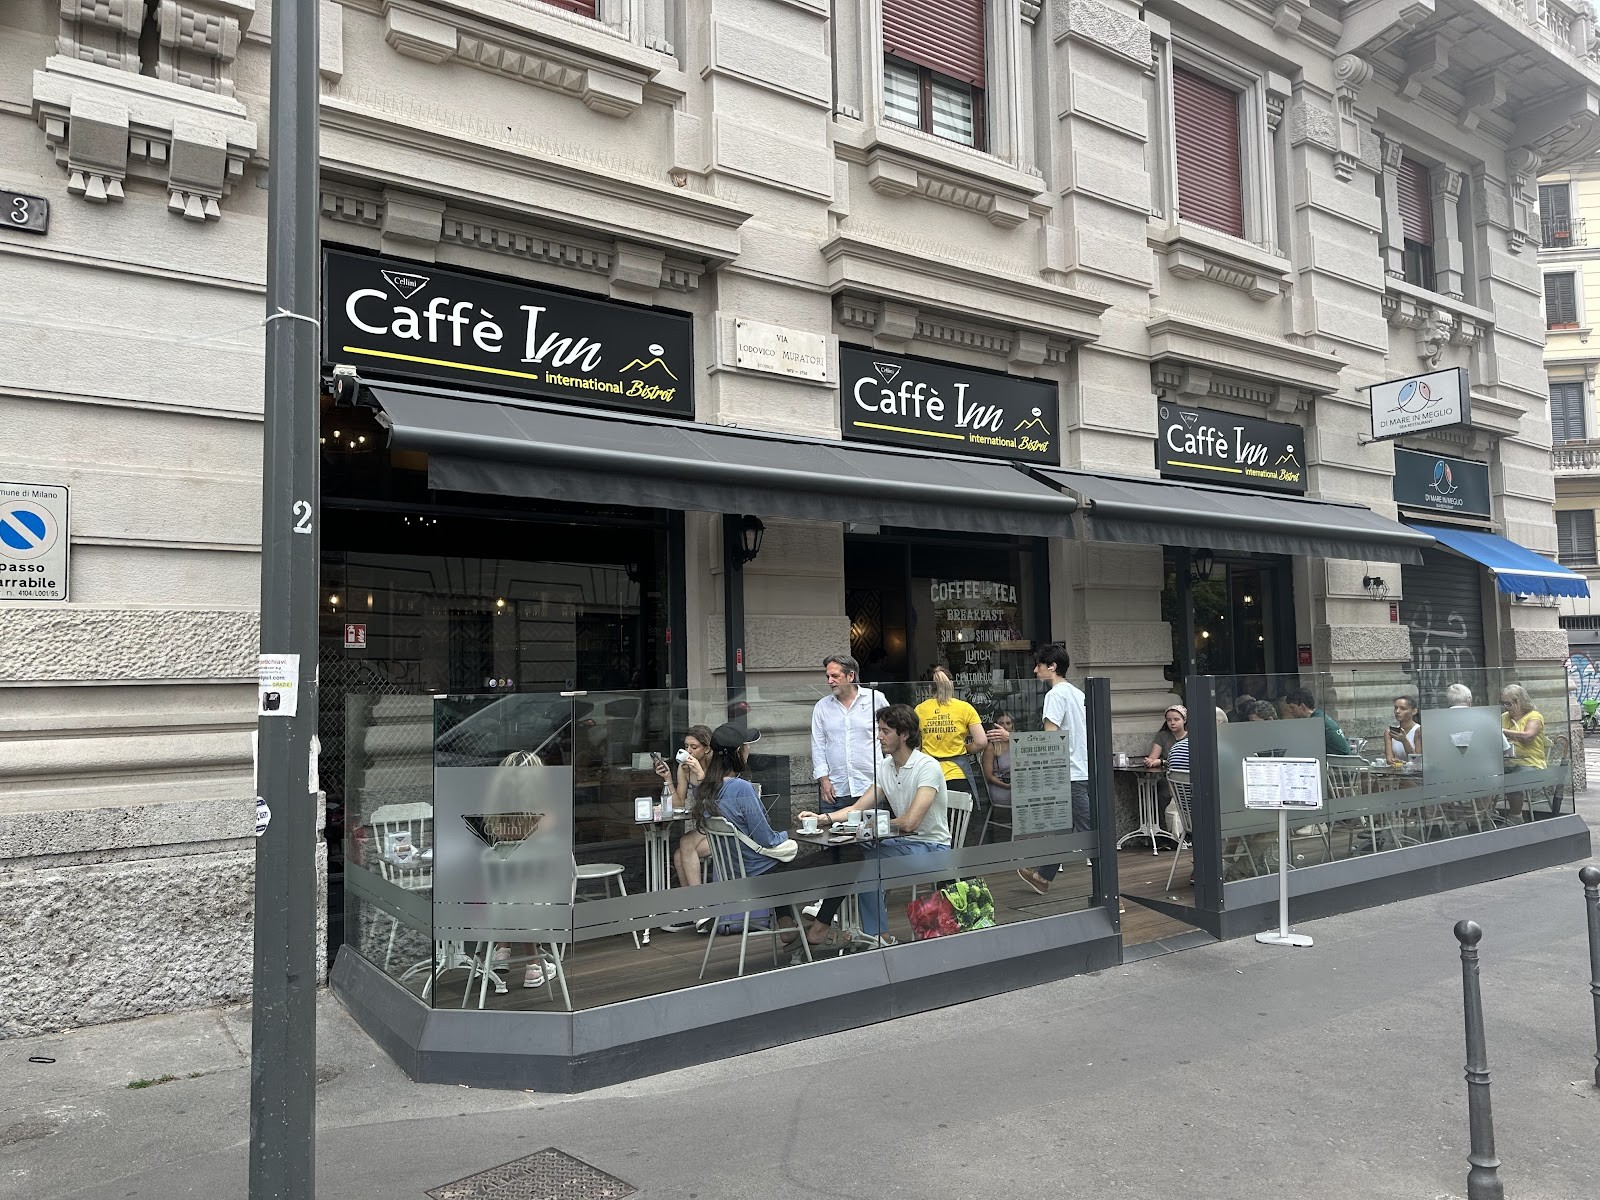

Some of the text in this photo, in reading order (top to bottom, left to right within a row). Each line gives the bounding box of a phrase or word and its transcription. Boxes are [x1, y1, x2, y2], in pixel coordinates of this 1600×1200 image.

[11, 198, 29, 224] 3
[394, 276, 417, 287] Cellini
[346, 289, 602, 372] Caffè Inn
[776, 334, 789, 343] VIA
[739, 344, 824, 366] LODOVICO MURATORI
[545, 371, 676, 402] international Bistrot
[854, 377, 1004, 432] Caffè Inn
[1389, 415, 1411, 426] MARE
[1421, 408, 1453, 420] MEGLIO
[969, 433, 1050, 453] international Bistrot
[1167, 424, 1269, 467] Caffè Inn
[1245, 467, 1300, 483] international Bistrot
[0, 489, 20, 497] mune
[31, 490, 58, 499] Milano
[292, 500, 312, 534] 2
[0, 563, 45, 574] passo
[0, 577, 56, 588] arrabile
[930, 581, 981, 602] COFFEE
[992, 582, 1018, 604] TEA
[946, 608, 1004, 621] BREAKFAST
[483, 822, 522, 836] Cellini
